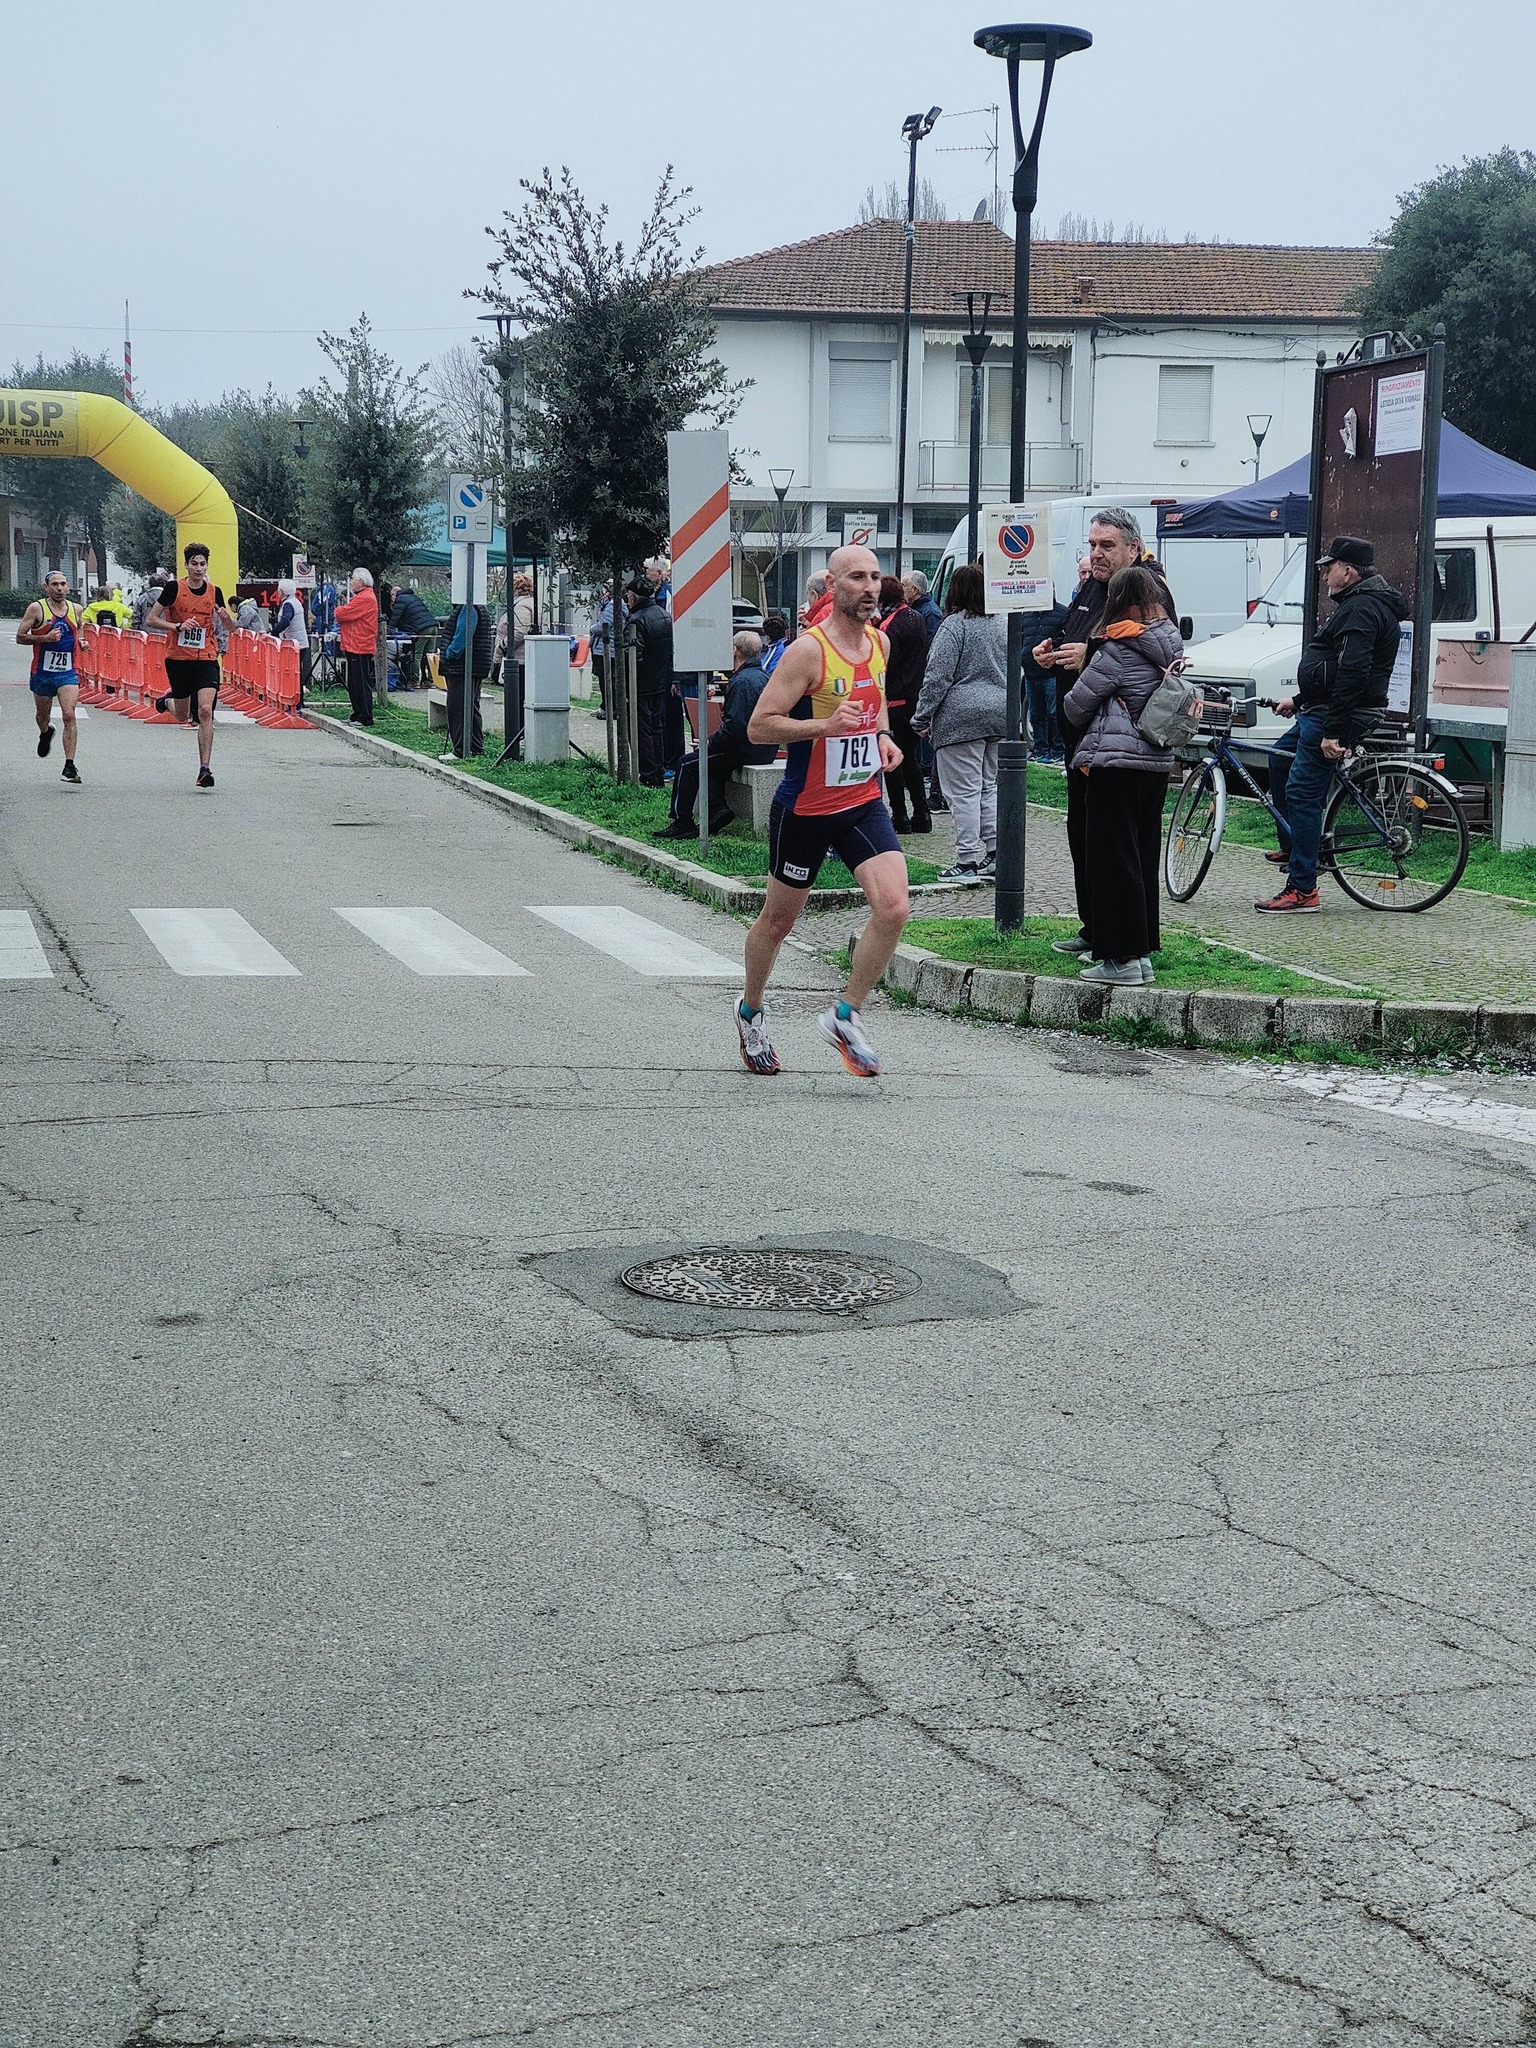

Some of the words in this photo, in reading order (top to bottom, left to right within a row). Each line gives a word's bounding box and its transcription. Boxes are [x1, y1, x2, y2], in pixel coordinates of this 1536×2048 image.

[0, 400, 64, 427] ISP
[22, 429, 65, 439] ITALIANA
[14, 438, 31, 446] PER
[35, 439, 59, 447] TUTTI
[455, 517, 464, 528] P
[184, 628, 203, 641] 666
[50, 652, 68, 666] 726
[840, 736, 872, 770] 762
